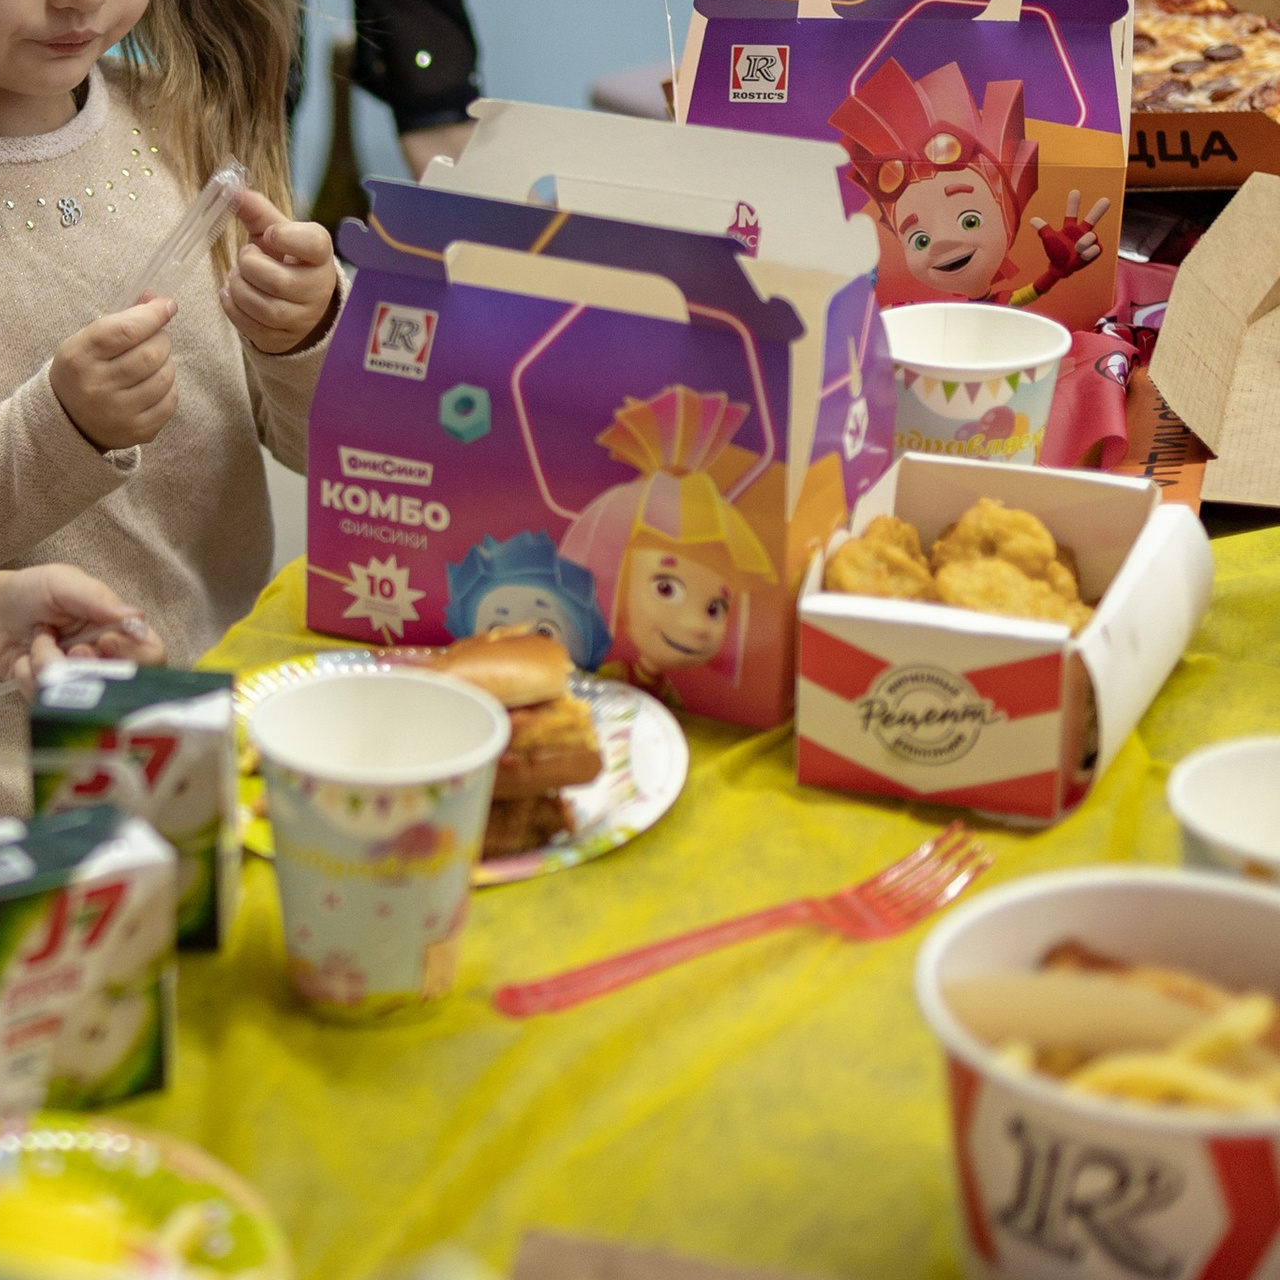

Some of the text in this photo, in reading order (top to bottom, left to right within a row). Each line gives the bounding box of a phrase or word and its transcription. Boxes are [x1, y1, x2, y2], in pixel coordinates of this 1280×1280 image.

[741, 54, 777, 82] R
[732, 91, 785, 100] ROSTIC'S
[1128, 130, 1238, 169] ЦЦА
[382, 317, 422, 354] R
[320, 478, 451, 532] КОМБО
[339, 518, 428, 550] ФИКСИКИ
[366, 574, 395, 599] 10
[22, 881, 131, 965] J7
